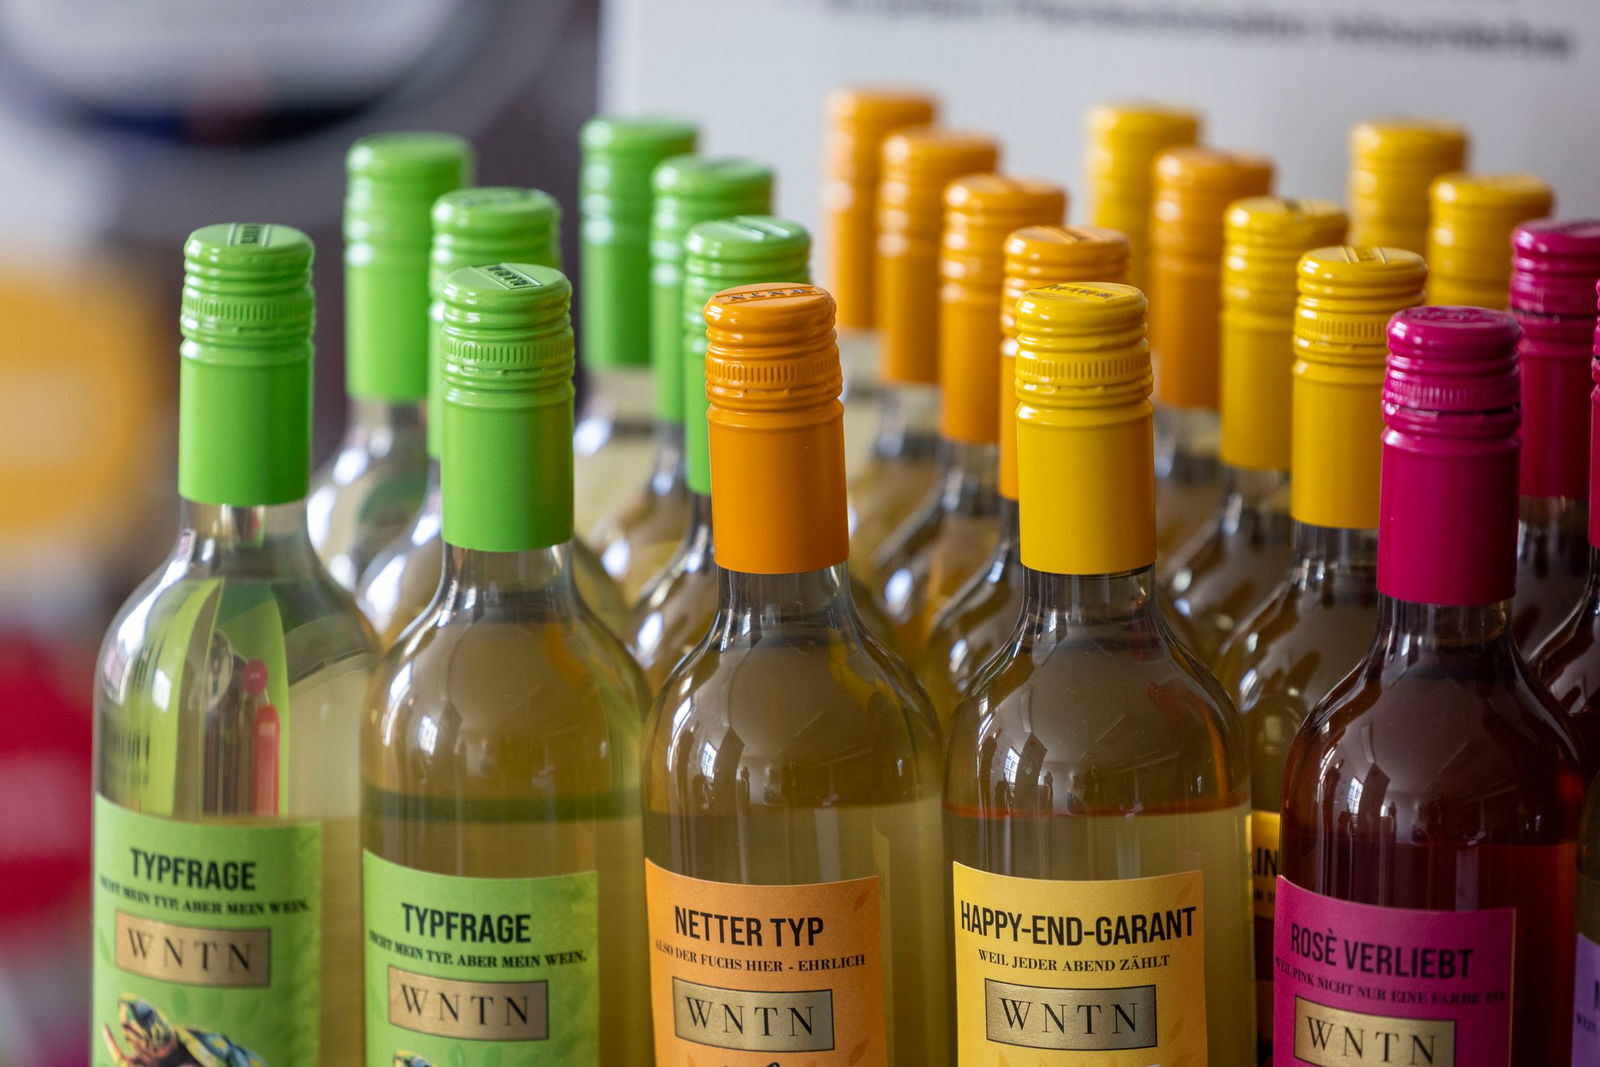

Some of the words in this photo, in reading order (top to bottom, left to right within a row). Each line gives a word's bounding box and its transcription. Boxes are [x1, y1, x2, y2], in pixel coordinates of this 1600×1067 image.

[130, 846, 257, 891] TYPFRAGE
[183, 900, 223, 914] ABER
[226, 901, 266, 916] MEIN
[401, 902, 532, 944] TYPFRAGE
[674, 905, 763, 947] NETTER
[769, 916, 824, 947] TYP
[960, 899, 1197, 946] HAPPY-END-GARANT
[127, 928, 252, 973] WNTN
[395, 941, 423, 960] MEIN
[457, 953, 497, 968] ABER
[501, 955, 541, 968] MEIN
[544, 950, 587, 966] WEIN.
[655, 939, 674, 957] ALSO
[675, 947, 698, 963] DER
[700, 953, 742, 970] FUCHS
[746, 960, 783, 972] HIER
[798, 954, 866, 972] EHRLICH
[978, 948, 1009, 967] WEIL
[1012, 955, 1057, 971] JEDER
[1062, 959, 1116, 972] ABEND
[1119, 954, 1170, 971] ZÄHLT
[1291, 921, 1338, 966] ROSÈ
[1344, 940, 1475, 979] VERLIEBT
[401, 984, 531, 1026] WNTN
[1293, 967, 1315, 988] PINK
[1317, 977, 1355, 997] NICHT
[1356, 986, 1386, 1002] NUR
[1391, 989, 1429, 1004] EINE
[684, 996, 815, 1037] WNTN
[999, 997, 1139, 1035] WNTN
[1305, 1015, 1438, 1066] WNTN
